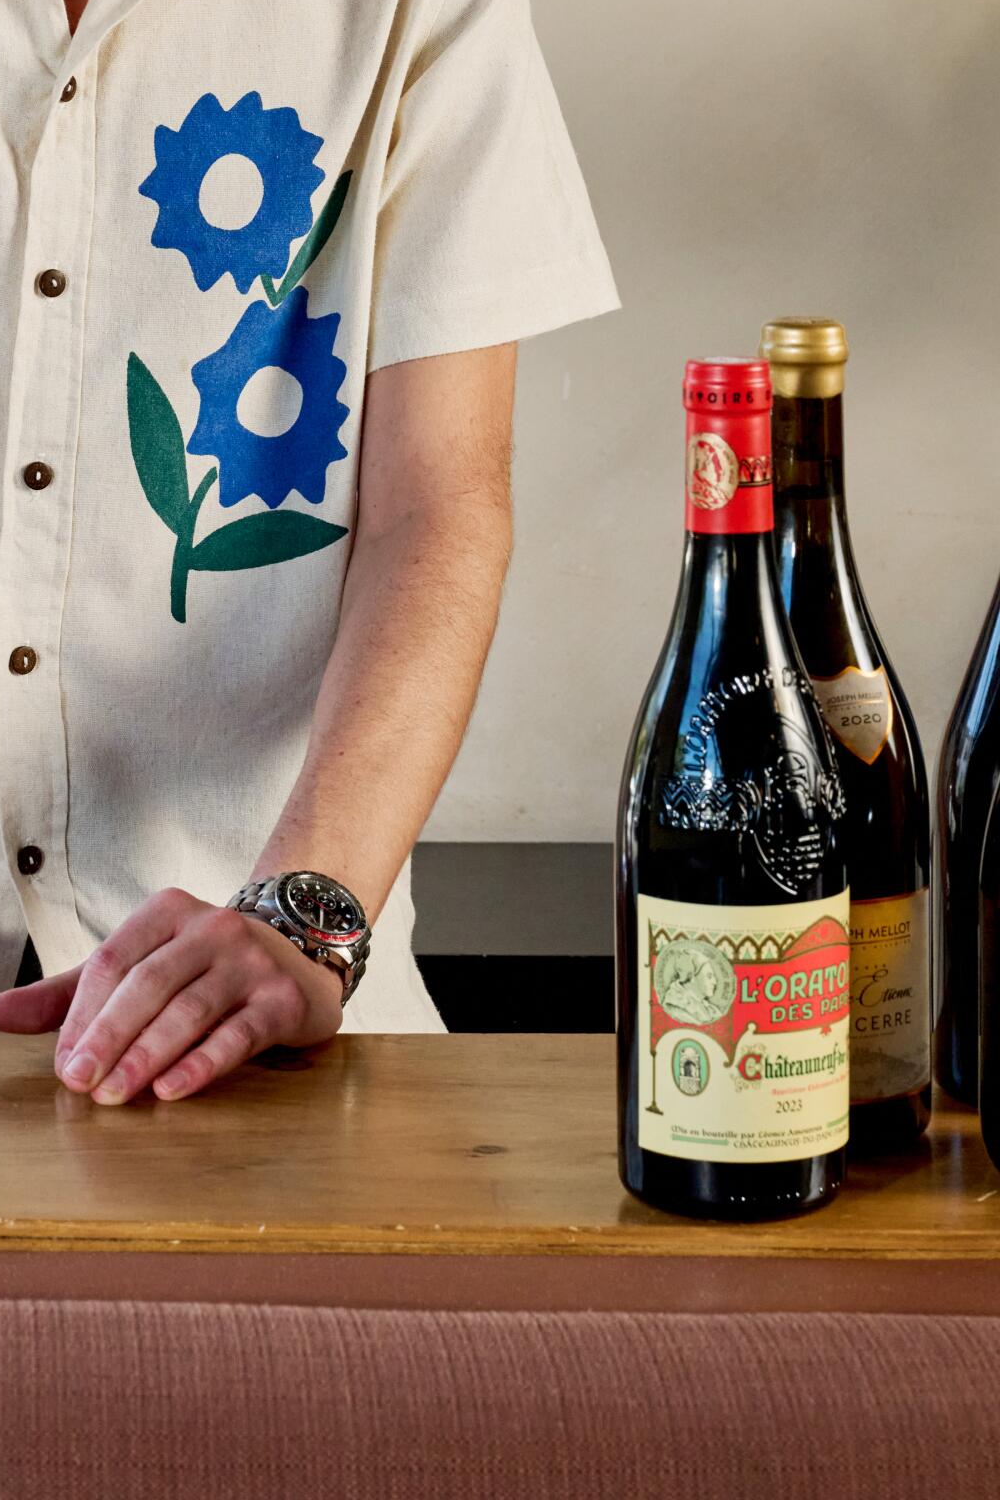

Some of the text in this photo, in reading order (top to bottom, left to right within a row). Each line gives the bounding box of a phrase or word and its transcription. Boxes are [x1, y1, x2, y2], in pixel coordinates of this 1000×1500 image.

[841, 713, 882, 727] 2020
[869, 921, 911, 939] MELLOT
[739, 961, 849, 1004] L'ORATO
[771, 990, 849, 1024] DES PAP
[775, 1099, 803, 1114] 2023
[702, 1129, 738, 1139] bouteille
[740, 1131, 755, 1140] par
